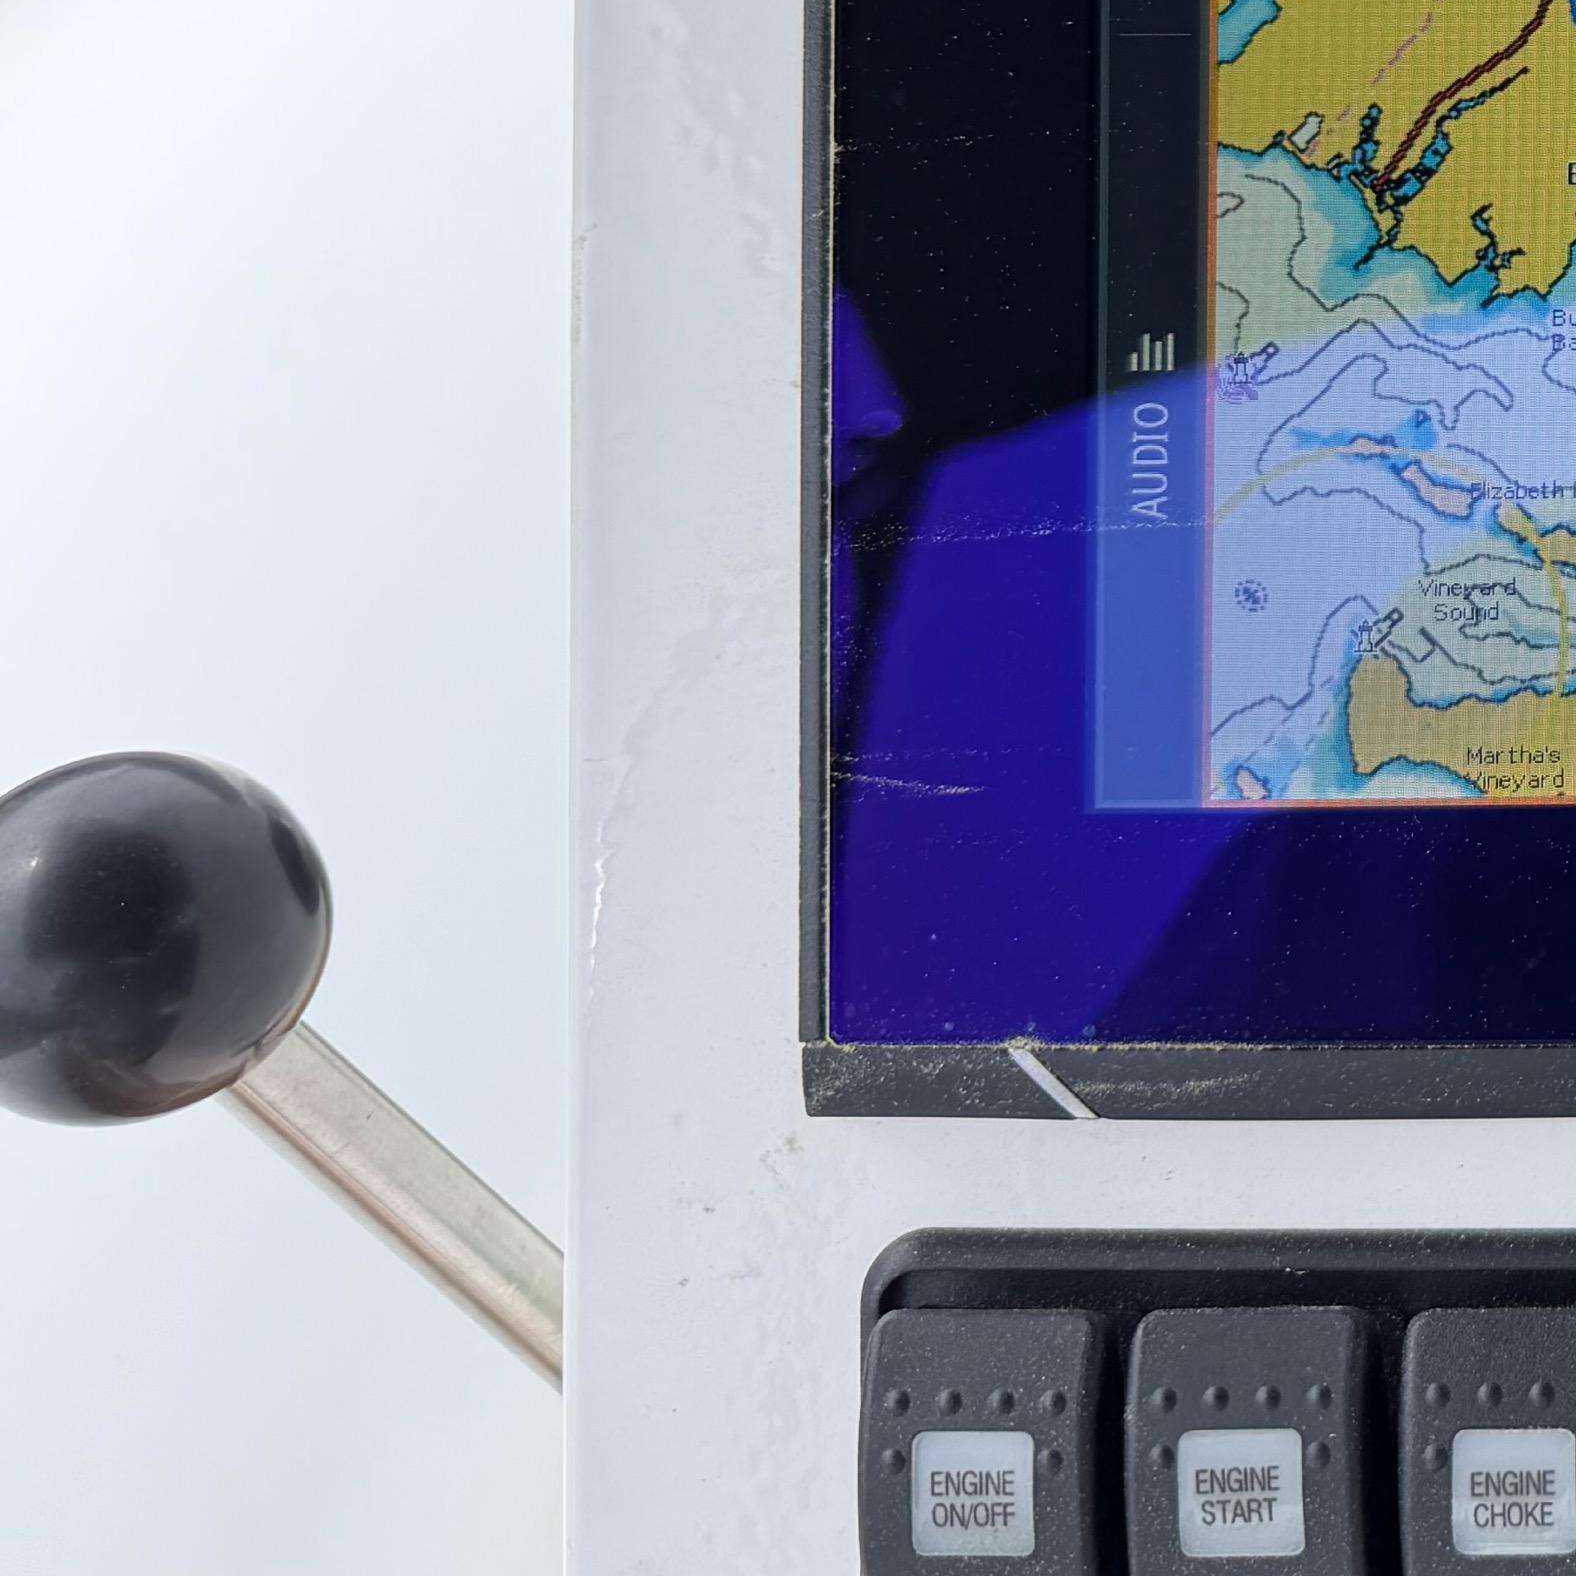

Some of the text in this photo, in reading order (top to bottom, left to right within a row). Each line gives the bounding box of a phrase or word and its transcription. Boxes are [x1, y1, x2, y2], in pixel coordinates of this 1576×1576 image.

[1130, 401, 1169, 521] AUDIO
[1470, 479, 1566, 500] Elizabeth
[1418, 576, 1517, 600] Vineyard
[1433, 600, 1500, 622] Sound
[1466, 744, 1561, 765] Martha's
[1465, 766, 1565, 792] Vineyard
[930, 1470, 1016, 1498] ENGINE
[1195, 1465, 1281, 1495] ENGINE
[1470, 1469, 1556, 1498] ENGINE
[931, 1502, 1016, 1531] ON/OFF
[1200, 1497, 1279, 1526] START
[1473, 1501, 1555, 1529] CHOKE
